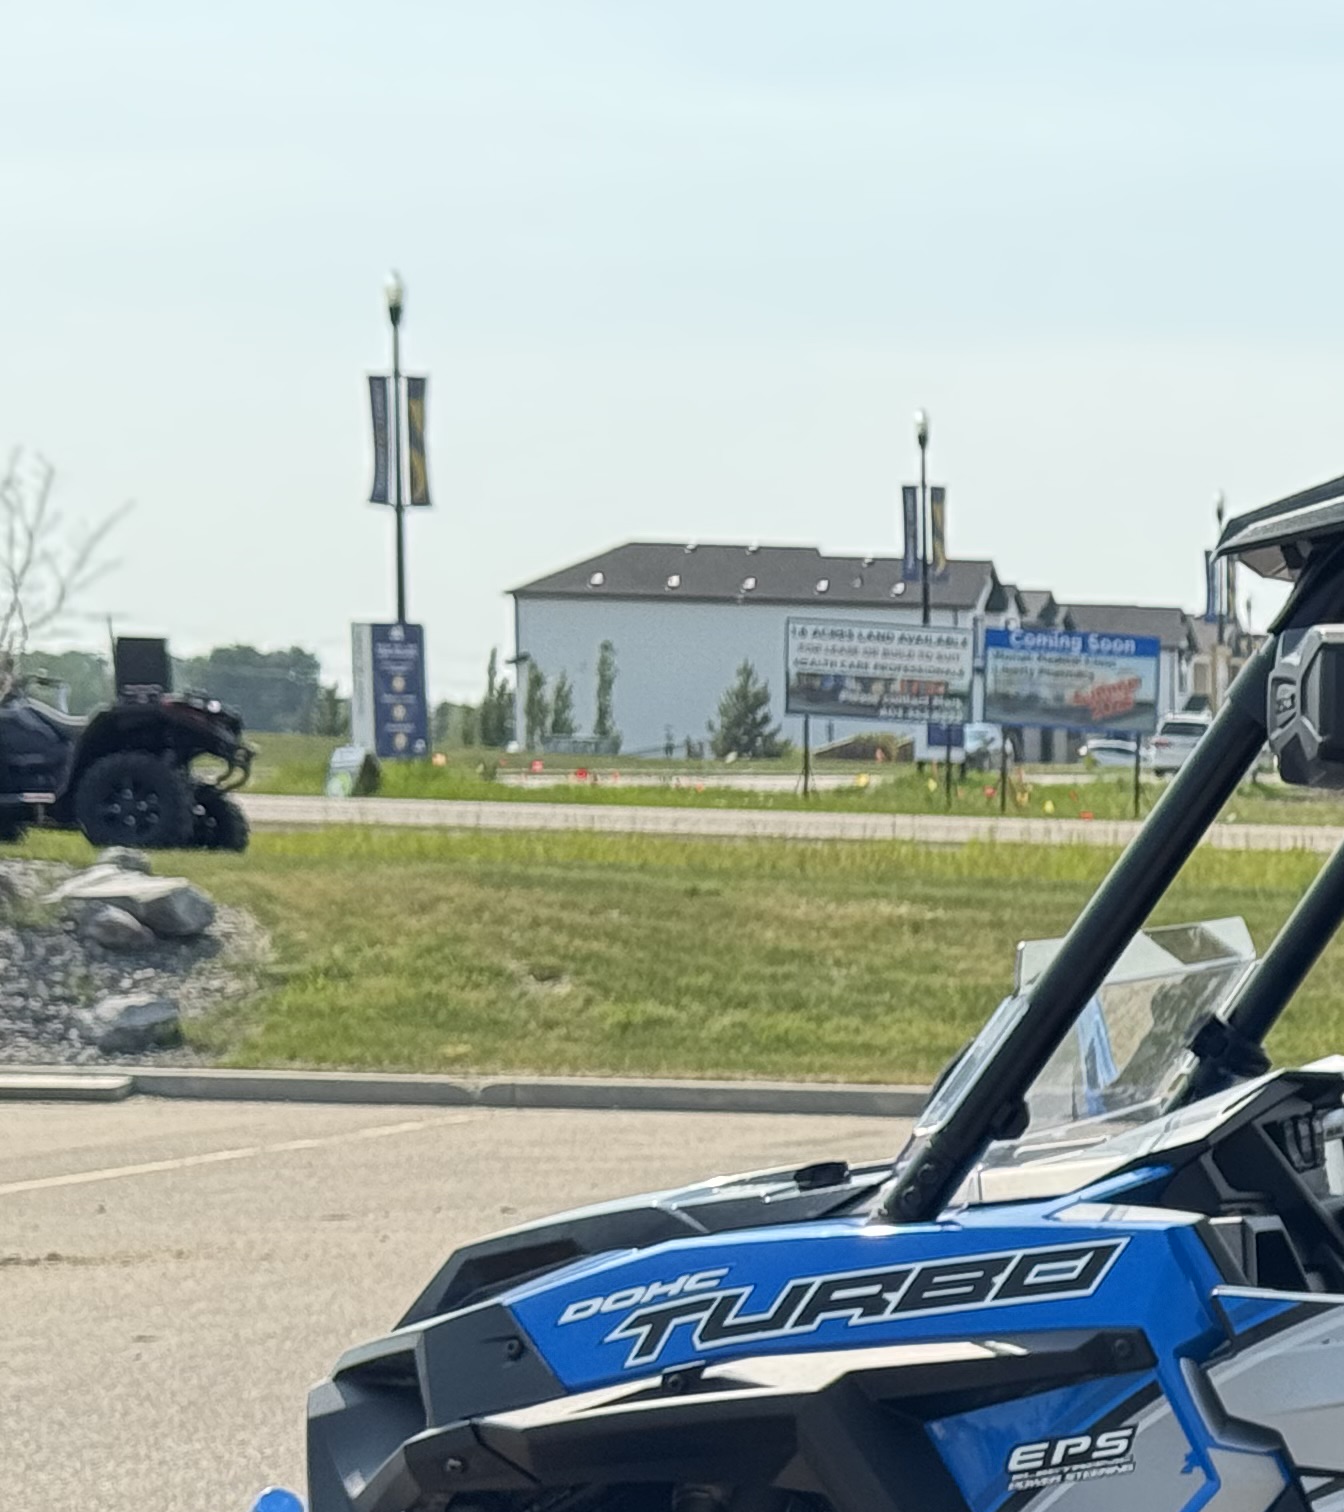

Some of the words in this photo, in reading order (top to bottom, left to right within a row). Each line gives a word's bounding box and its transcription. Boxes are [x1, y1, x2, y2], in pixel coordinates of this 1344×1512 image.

[1009, 629, 1082, 654] Coming
[1088, 633, 1136, 654] Soon
[558, 1266, 735, 1326] DOHC
[603, 1236, 1131, 1368] TURBO
[1007, 1427, 1134, 1472] EPS
